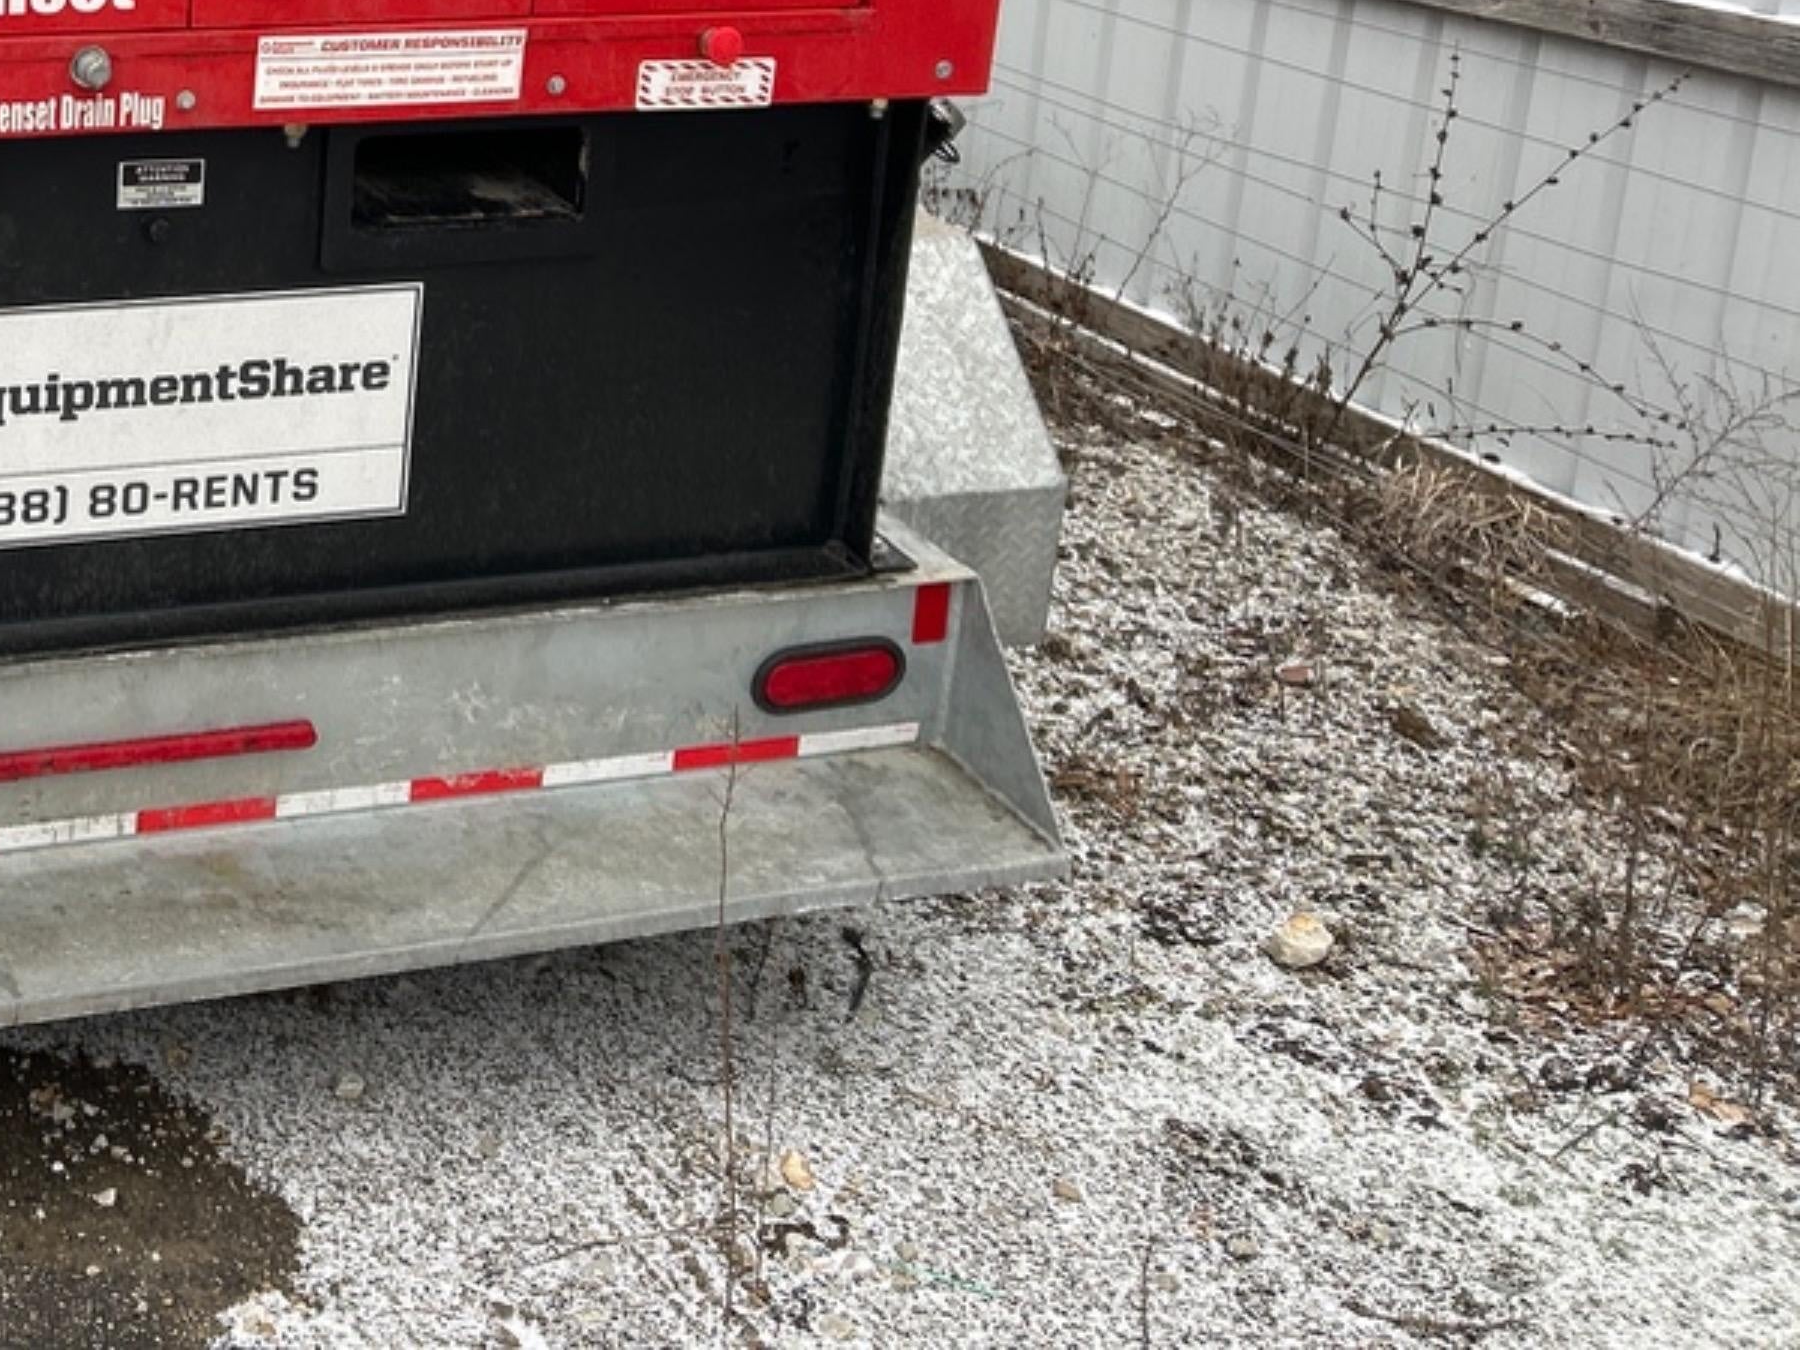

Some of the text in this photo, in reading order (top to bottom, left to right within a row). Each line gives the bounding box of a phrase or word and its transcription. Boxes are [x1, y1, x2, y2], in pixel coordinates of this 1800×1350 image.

[320, 38, 401, 52] CUSTOMER
[404, 35, 524, 50] RESPONSIBILITY
[670, 69, 743, 82] EMERGENCY
[701, 83, 746, 96] BUTTON
[59, 92, 116, 130] Drain
[119, 91, 165, 130] Plug
[88, 468, 320, 517] 80-RENTS
